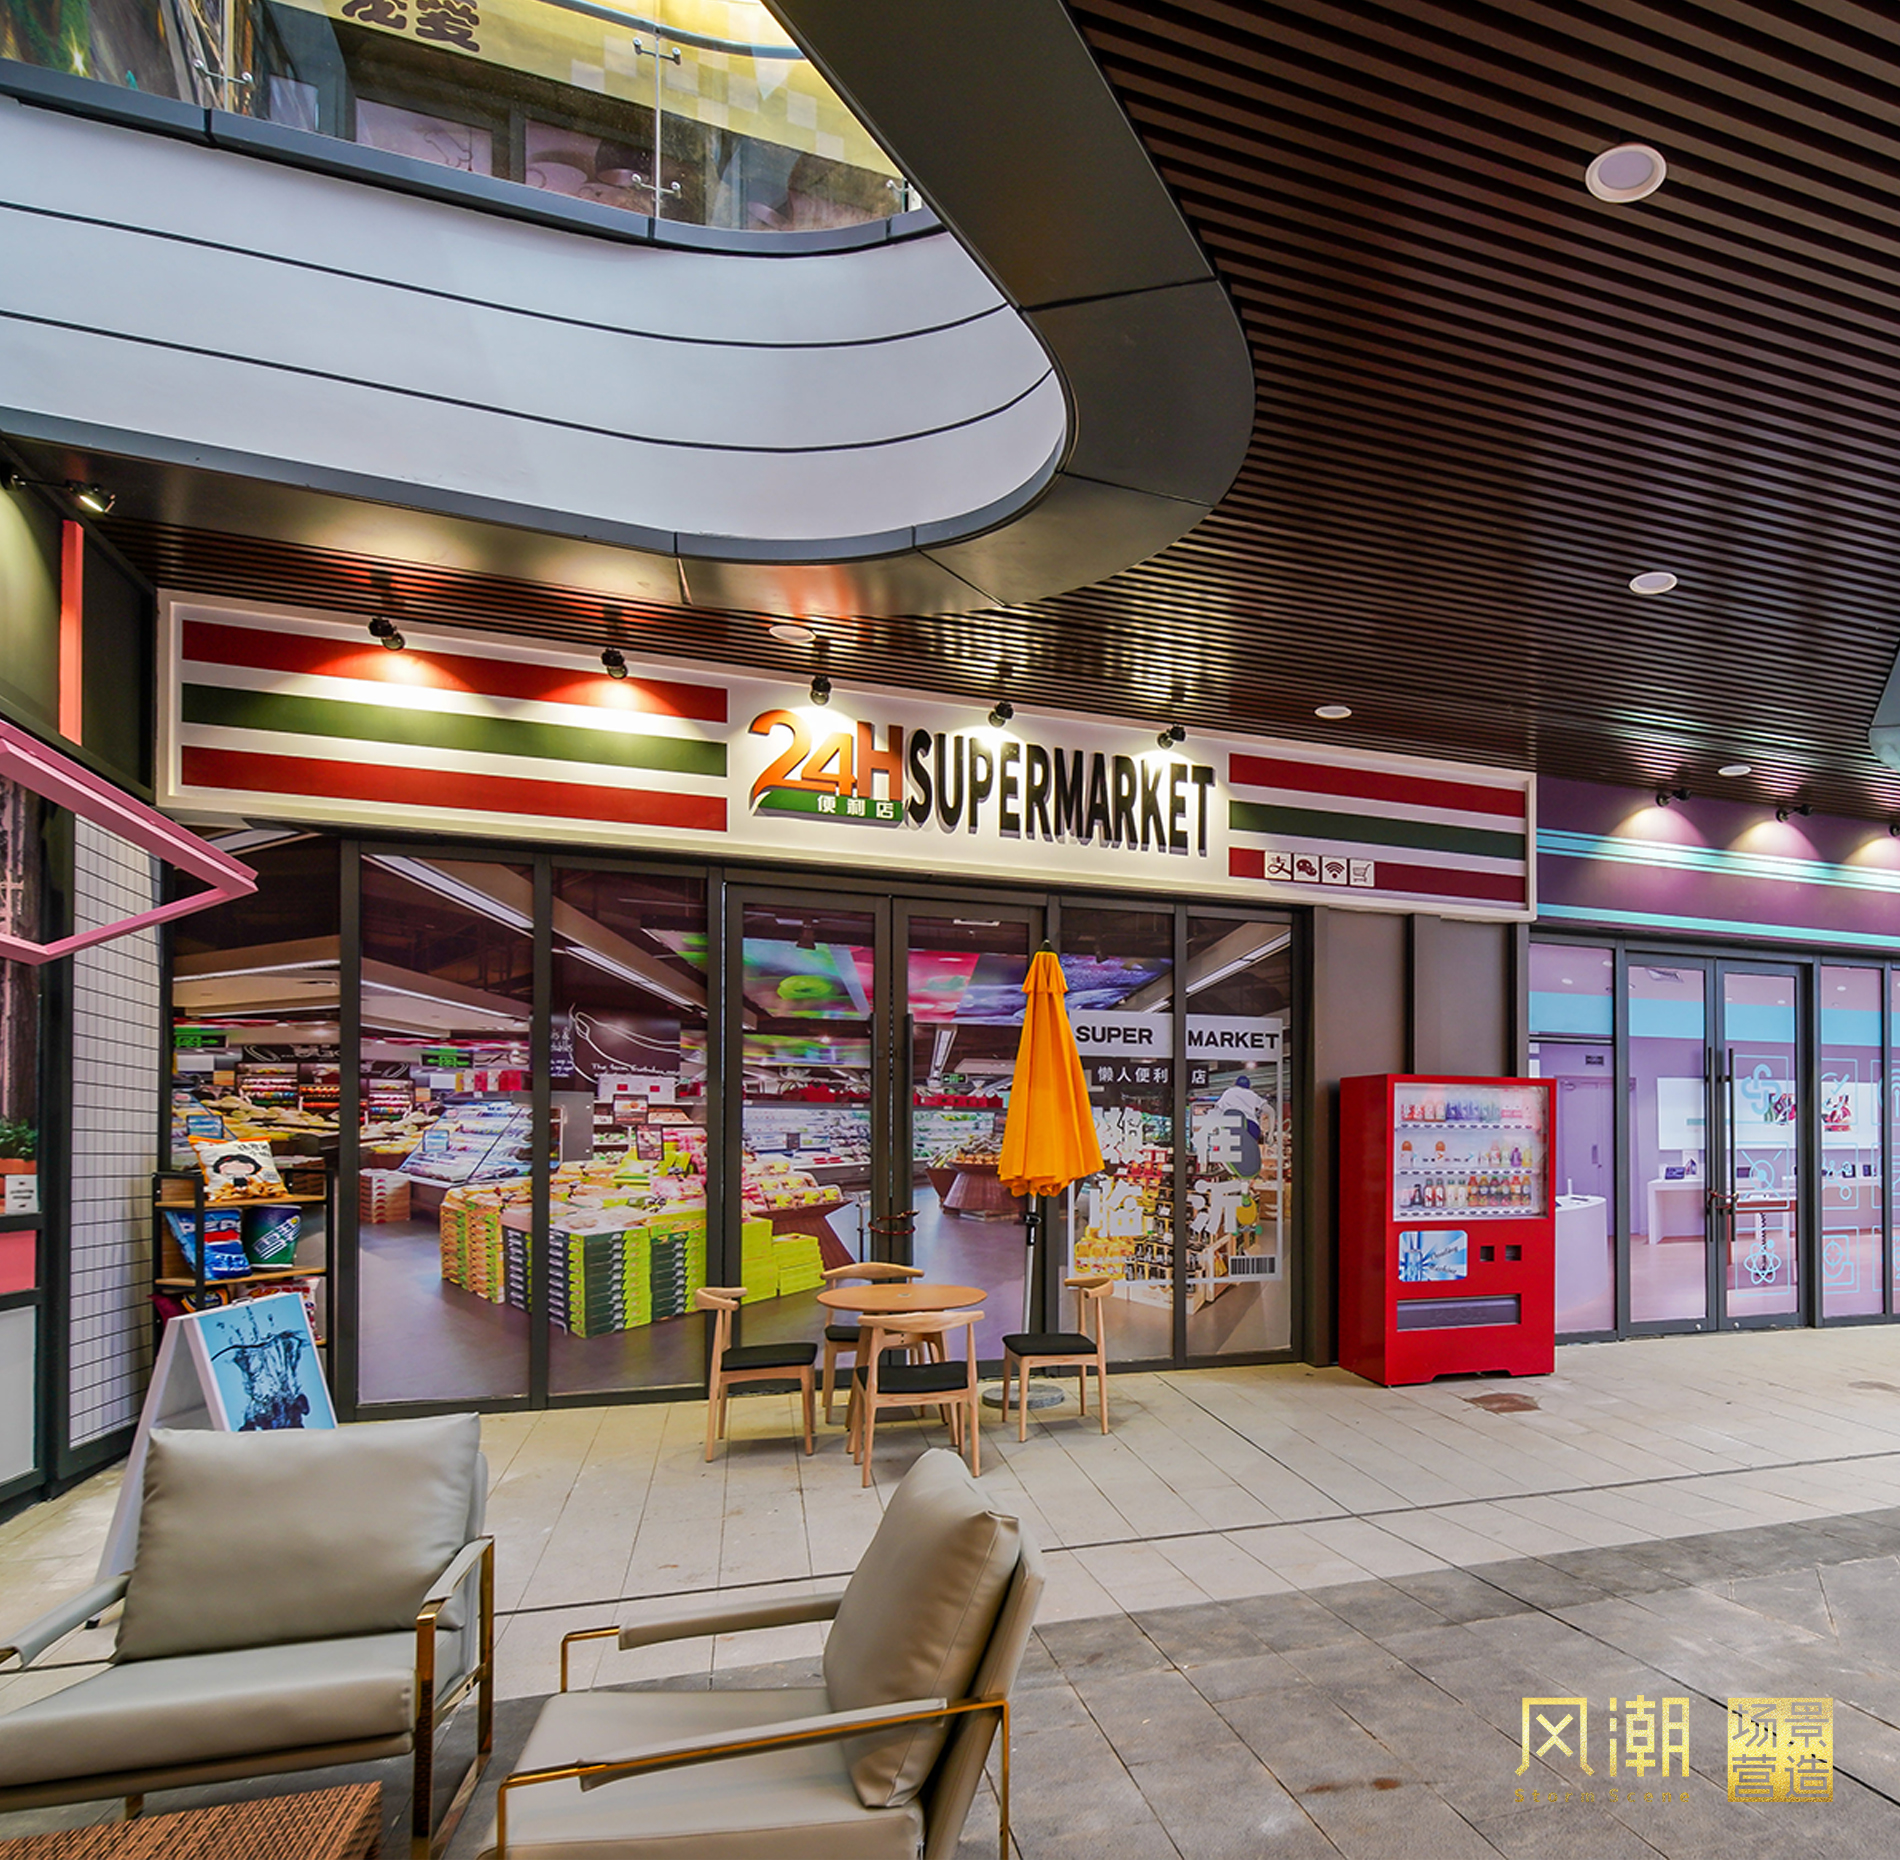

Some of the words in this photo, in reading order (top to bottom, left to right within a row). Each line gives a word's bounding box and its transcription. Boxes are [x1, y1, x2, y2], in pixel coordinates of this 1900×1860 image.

[748, 708, 904, 808] 24H
[906, 728, 1216, 857] SUPERMARKET
[817, 794, 894, 819] 便利店
[1075, 1025, 1153, 1045] SUPER
[1187, 1030, 1280, 1050] MARKET
